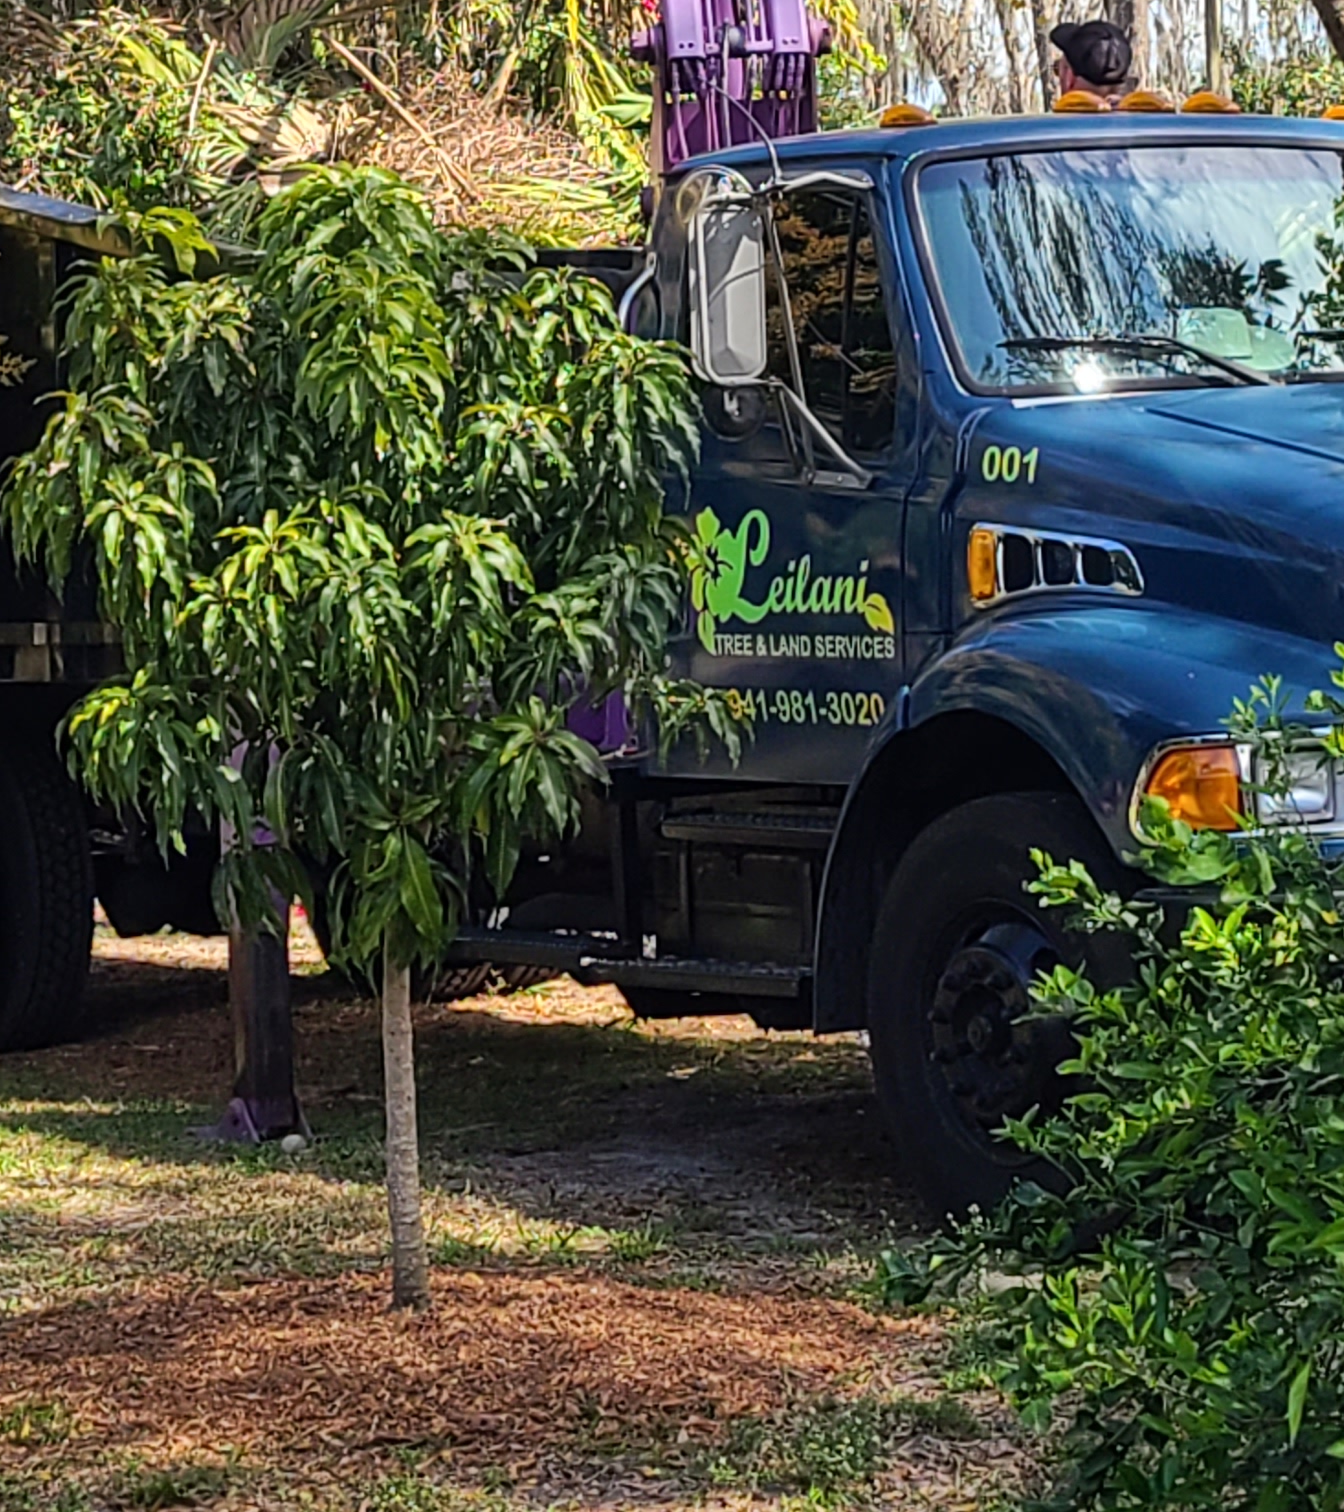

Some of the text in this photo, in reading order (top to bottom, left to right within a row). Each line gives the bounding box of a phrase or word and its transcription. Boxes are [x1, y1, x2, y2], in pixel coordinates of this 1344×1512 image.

[982, 445, 1039, 484] 001
[730, 509, 870, 624] Leilani
[715, 633, 896, 659] TREE & LAND SERVICES
[727, 688, 886, 726] 941-981-3020
